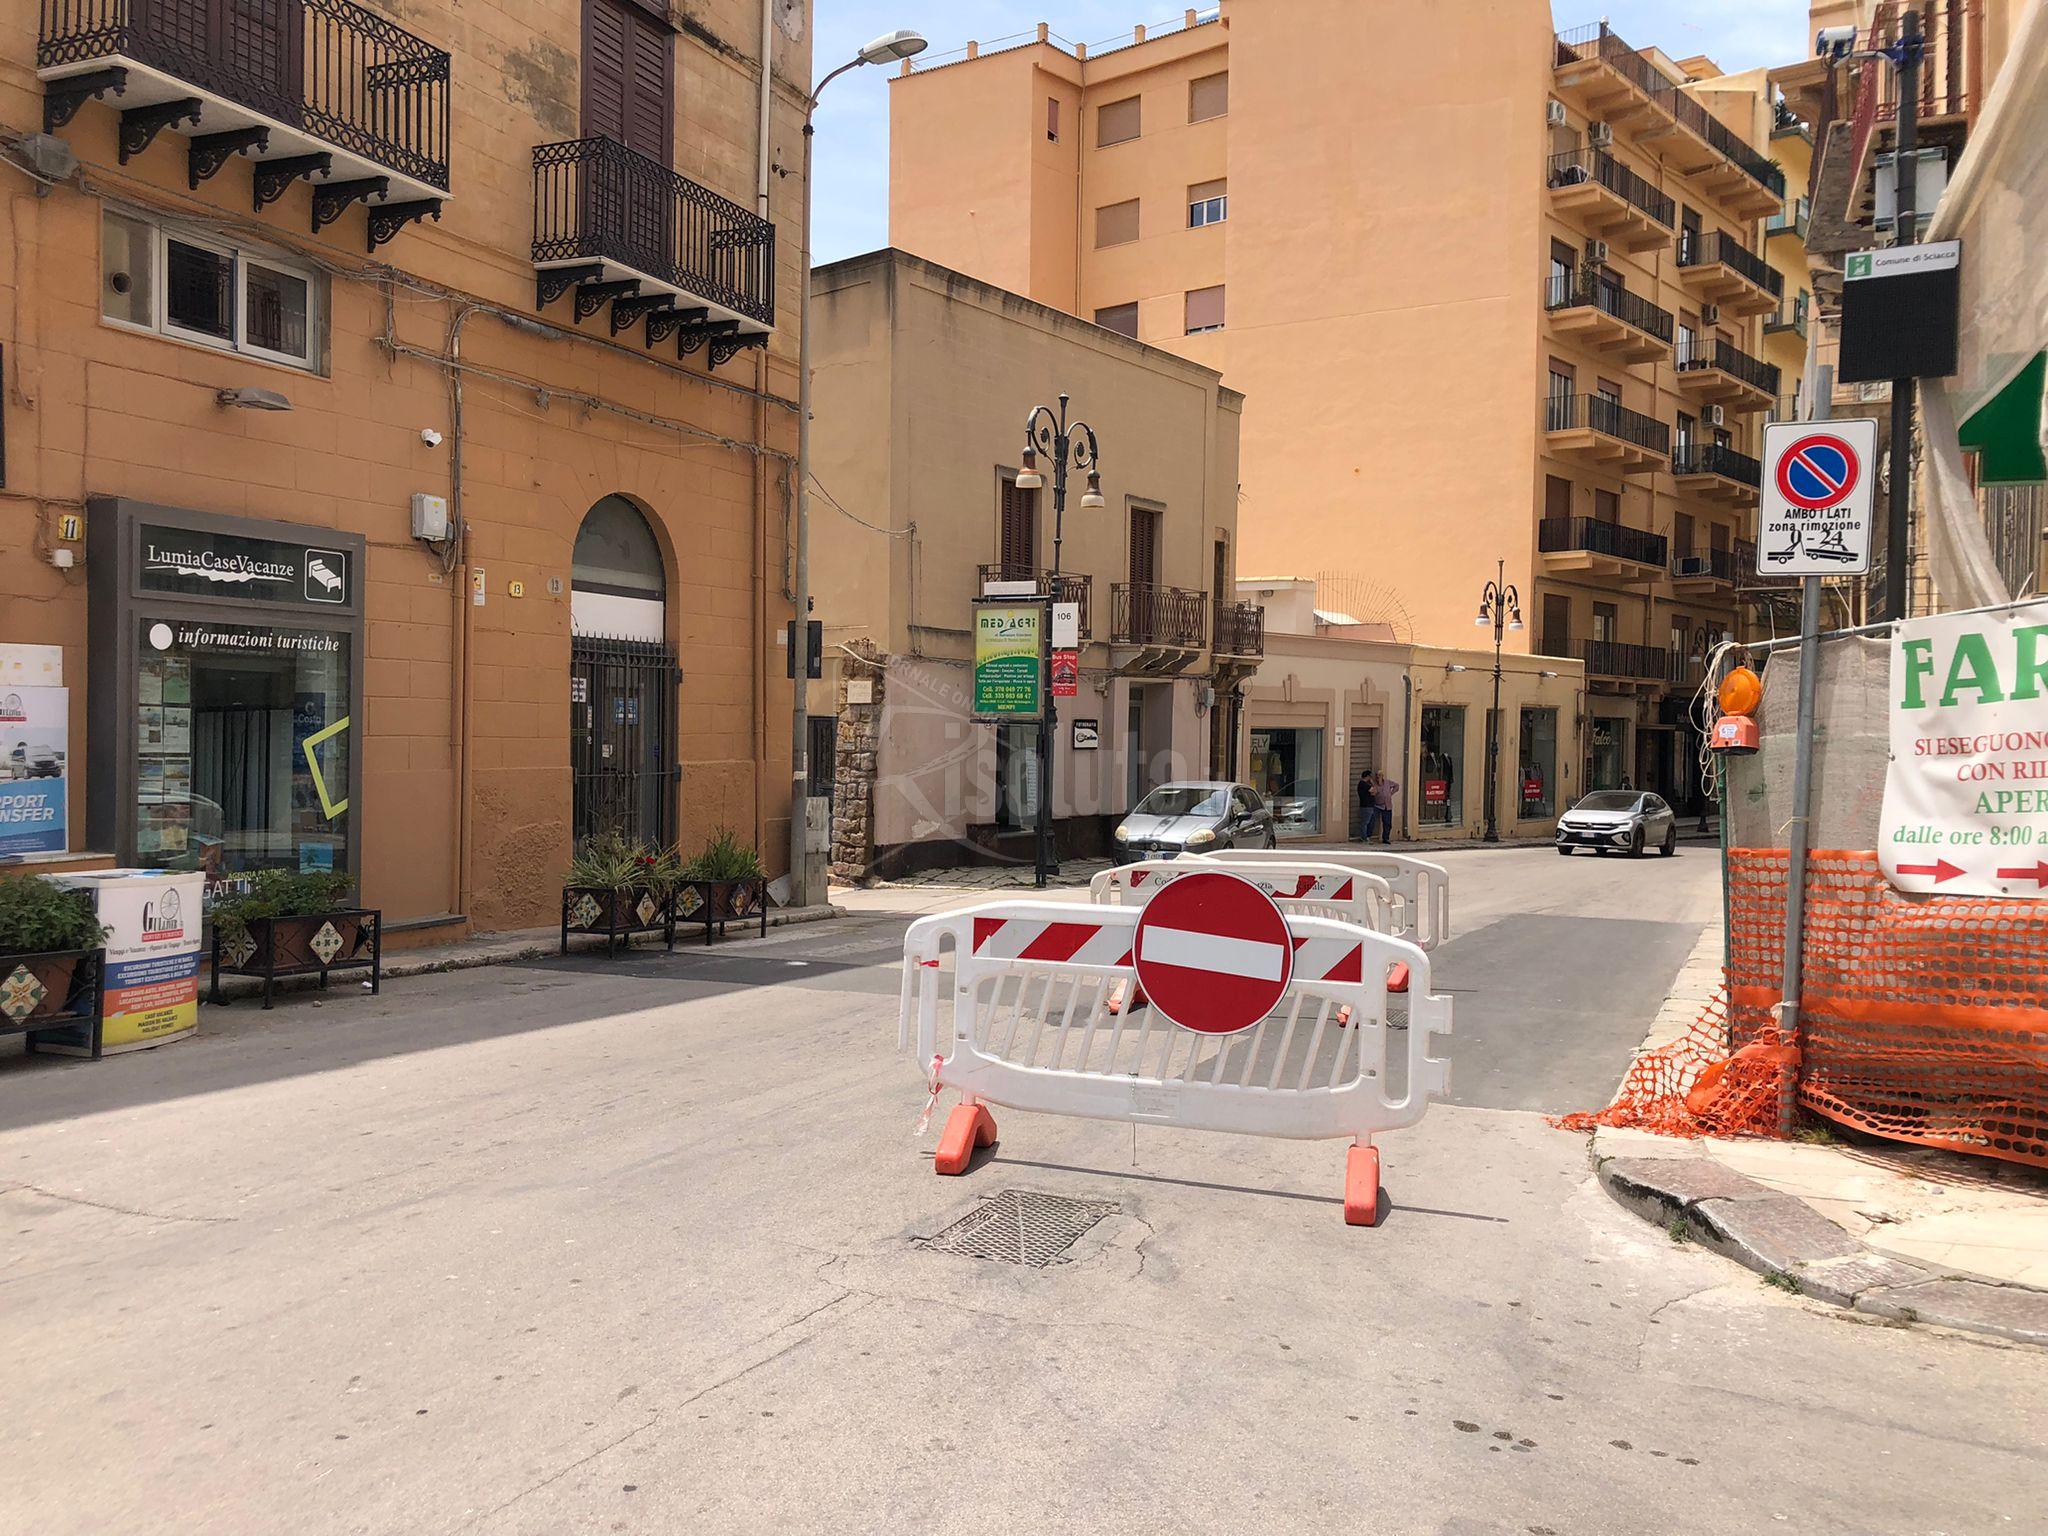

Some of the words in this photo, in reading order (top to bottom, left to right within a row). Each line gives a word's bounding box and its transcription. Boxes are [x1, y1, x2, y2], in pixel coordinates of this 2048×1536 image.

[1875, 256, 1911, 267] Comune
[1912, 254, 1922, 262] di
[1924, 251, 1956, 261] Sciacca
[1784, 508, 1817, 519] AMBO
[1827, 508, 1851, 519] LATI
[64, 518, 77, 539] 11
[1768, 522, 1796, 532] zona
[1801, 519, 1861, 532] rimozione
[1820, 529, 1844, 545] 24
[148, 545, 294, 576] LumiaCaseVacanze
[513, 584, 521, 594] 13
[1057, 612, 1072, 620] 106
[178, 627, 274, 648] informazioni
[277, 635, 340, 652] turistiche
[1900, 624, 2048, 710] FAR
[297, 713, 322, 724] Costa
[1914, 738, 1933, 756] SI
[1957, 761, 2006, 782] CON
[0, 794, 48, 809] PORT
[1893, 824, 1944, 845] dalle
[1949, 830, 1984, 846] ore
[1989, 825, 2033, 846] 8:00
[228, 870, 257, 881] AGENZIA
